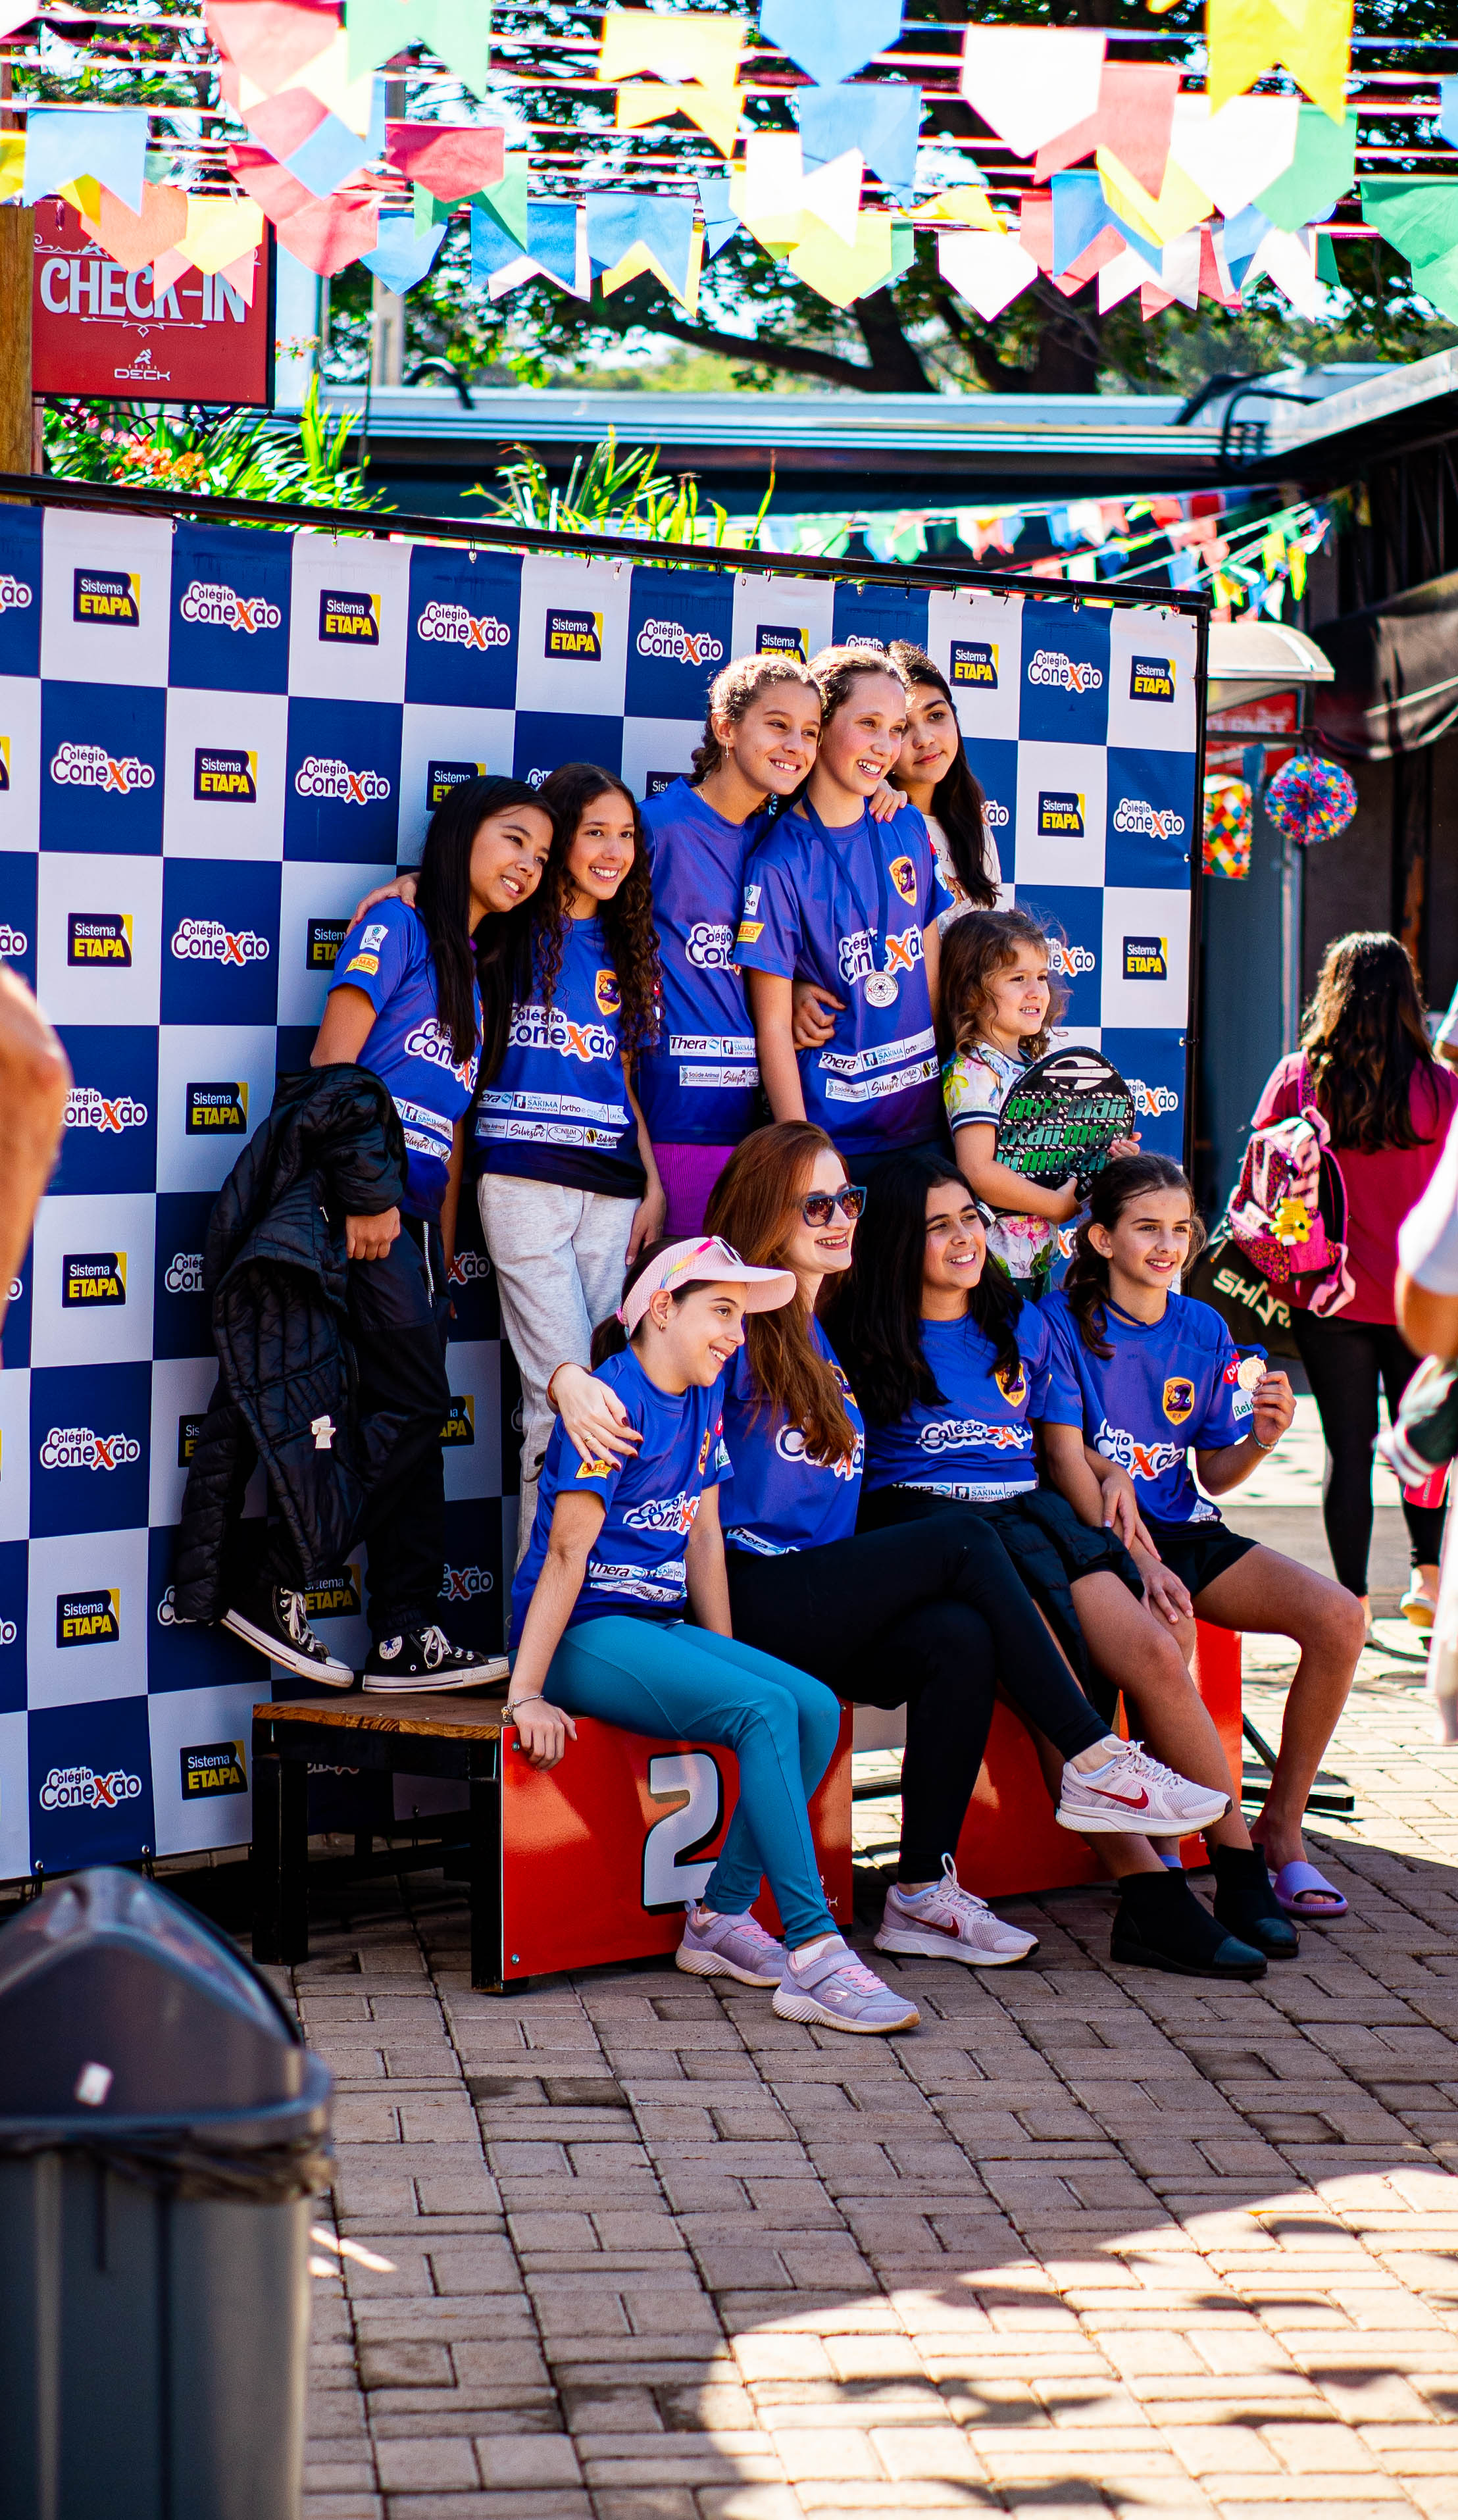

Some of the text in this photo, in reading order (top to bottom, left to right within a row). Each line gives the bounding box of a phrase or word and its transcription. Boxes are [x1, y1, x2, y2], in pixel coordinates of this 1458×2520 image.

[114, 368, 170, 381] DECK
[80, 579, 122, 595] Sistema
[191, 584, 234, 603] Colégio
[80, 596, 132, 617] ETAPA
[326, 600, 364, 615] Sistema
[428, 604, 467, 621] Colégio
[326, 616, 372, 636] ETAPA
[552, 618, 588, 632] Sistema
[647, 622, 682, 638] Colégio
[551, 634, 595, 653] ETAPA
[761, 634, 795, 647] Sistema
[955, 649, 987, 664] Sistema
[1036, 651, 1068, 667] Colégio
[955, 665, 993, 680] ETAPA
[1136, 664, 1165, 677] Sistema
[1134, 678, 1170, 695] ETAPA
[63, 745, 105, 763] Colégio
[201, 758, 241, 772] Sistema
[306, 759, 346, 777] Colégio
[201, 774, 249, 794] ETAPA
[434, 770, 470, 783] Sistema
[653, 781, 668, 792] Sist
[1043, 799, 1073, 811] Sistema
[1121, 800, 1149, 815] Colégio
[1042, 813, 1080, 830] ETAPA
[75, 923, 116, 937] Sistema
[182, 921, 223, 939] Colégio
[314, 928, 346, 941] Sistem
[74, 938, 124, 958] ETAPA
[313, 944, 339, 961] ETA
[1127, 944, 1156, 956] Sistema
[1127, 957, 1162, 974] ETAPA
[670, 1037, 707, 1049] Thera
[823, 1053, 855, 1069] Thera
[878, 1048, 903, 1061] SAKIMA
[66, 1091, 99, 1107] olégio
[193, 1092, 232, 1105] Sistema
[528, 1099, 558, 1108] SAKIMA
[192, 1107, 239, 1126] ETAPA
[1007, 1098, 1128, 1119] mormaii
[70, 1264, 110, 1277] Sistema
[176, 1255, 204, 1271] Colég
[69, 1278, 118, 1298] ETAPA
[439, 1420, 466, 1438] APA
[51, 1429, 92, 1446] Colégio
[305, 1589, 353, 1610] ETAPA
[64, 1602, 103, 1616] Sistema
[63, 1616, 113, 1638] ETAPA
[188, 1753, 230, 1769] Sistema
[50, 1769, 92, 1786] Colégio
[188, 1767, 240, 1790] ETAPA
[644, 1753, 720, 1907] 2
